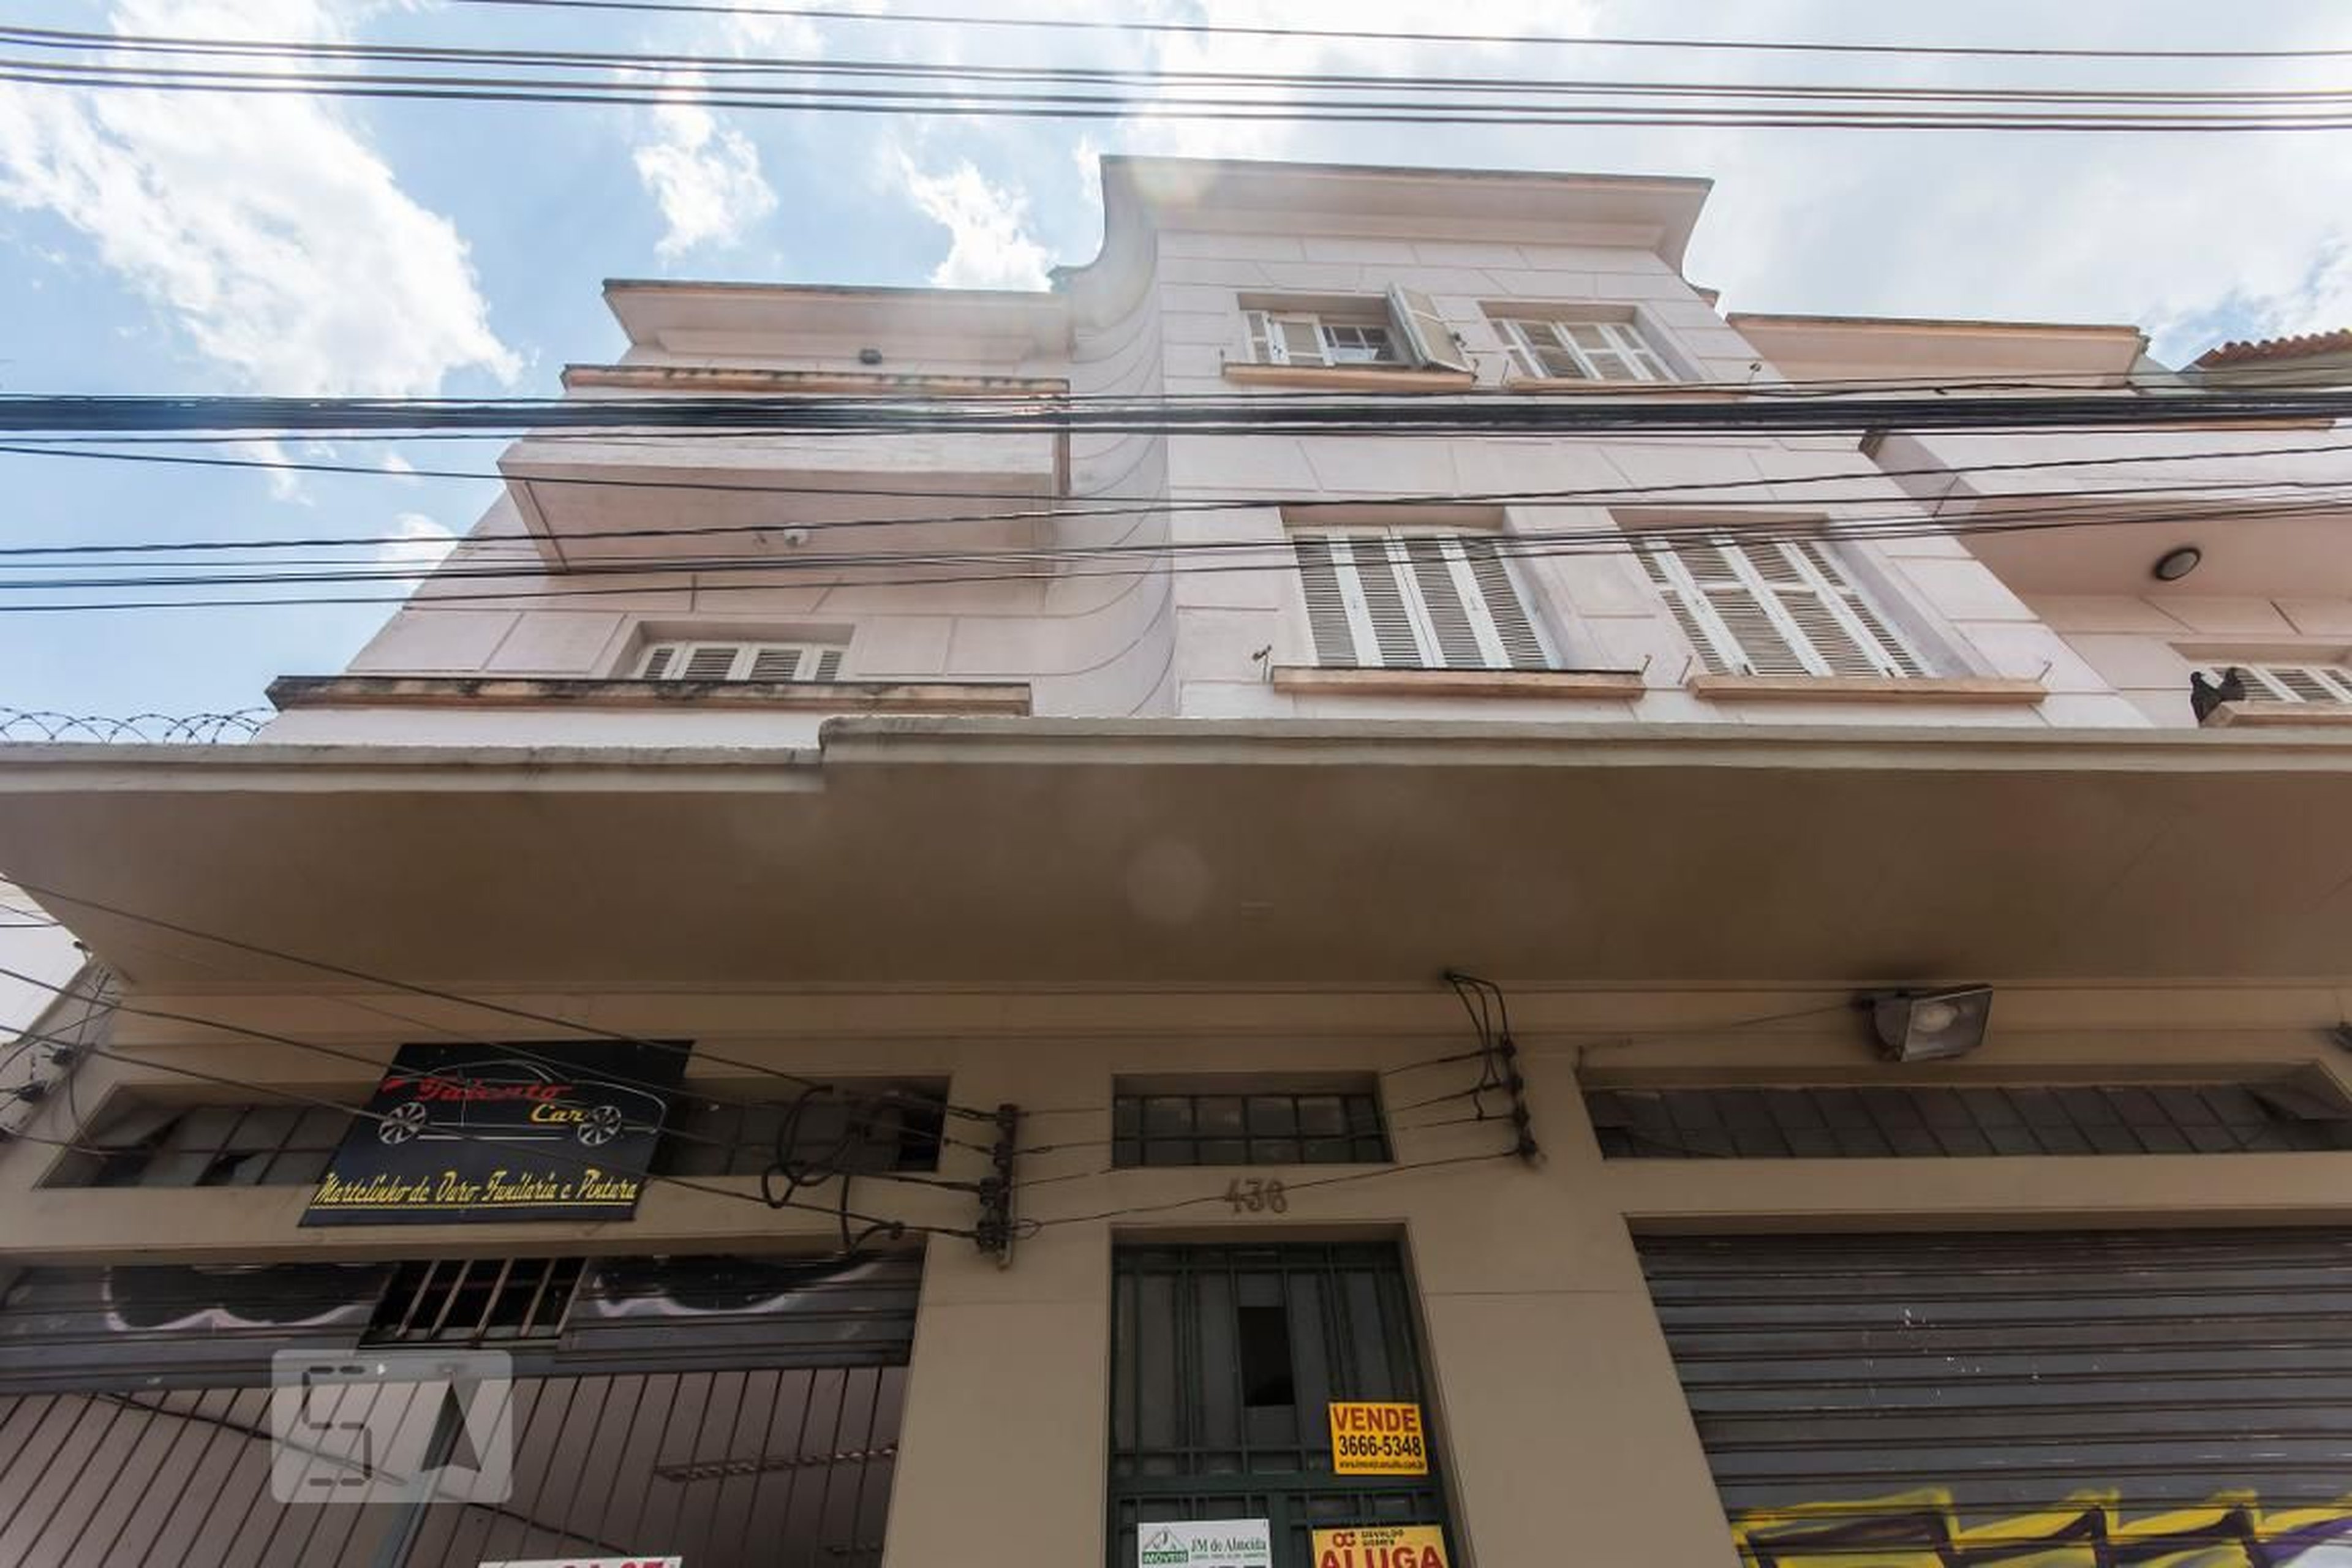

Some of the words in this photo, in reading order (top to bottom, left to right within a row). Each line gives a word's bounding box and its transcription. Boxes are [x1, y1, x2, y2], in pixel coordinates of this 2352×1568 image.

[530, 1104, 584, 1123] Car
[314, 1172, 412, 1203] Martelinho
[408, 1175, 430, 1202] de
[481, 1170, 557, 1201] Funilaria
[560, 1183, 572, 1199] e
[575, 1169, 638, 1199] Pintura
[1333, 1407, 1418, 1432] VENDE
[1339, 1434, 1422, 1457] 3666-5348
